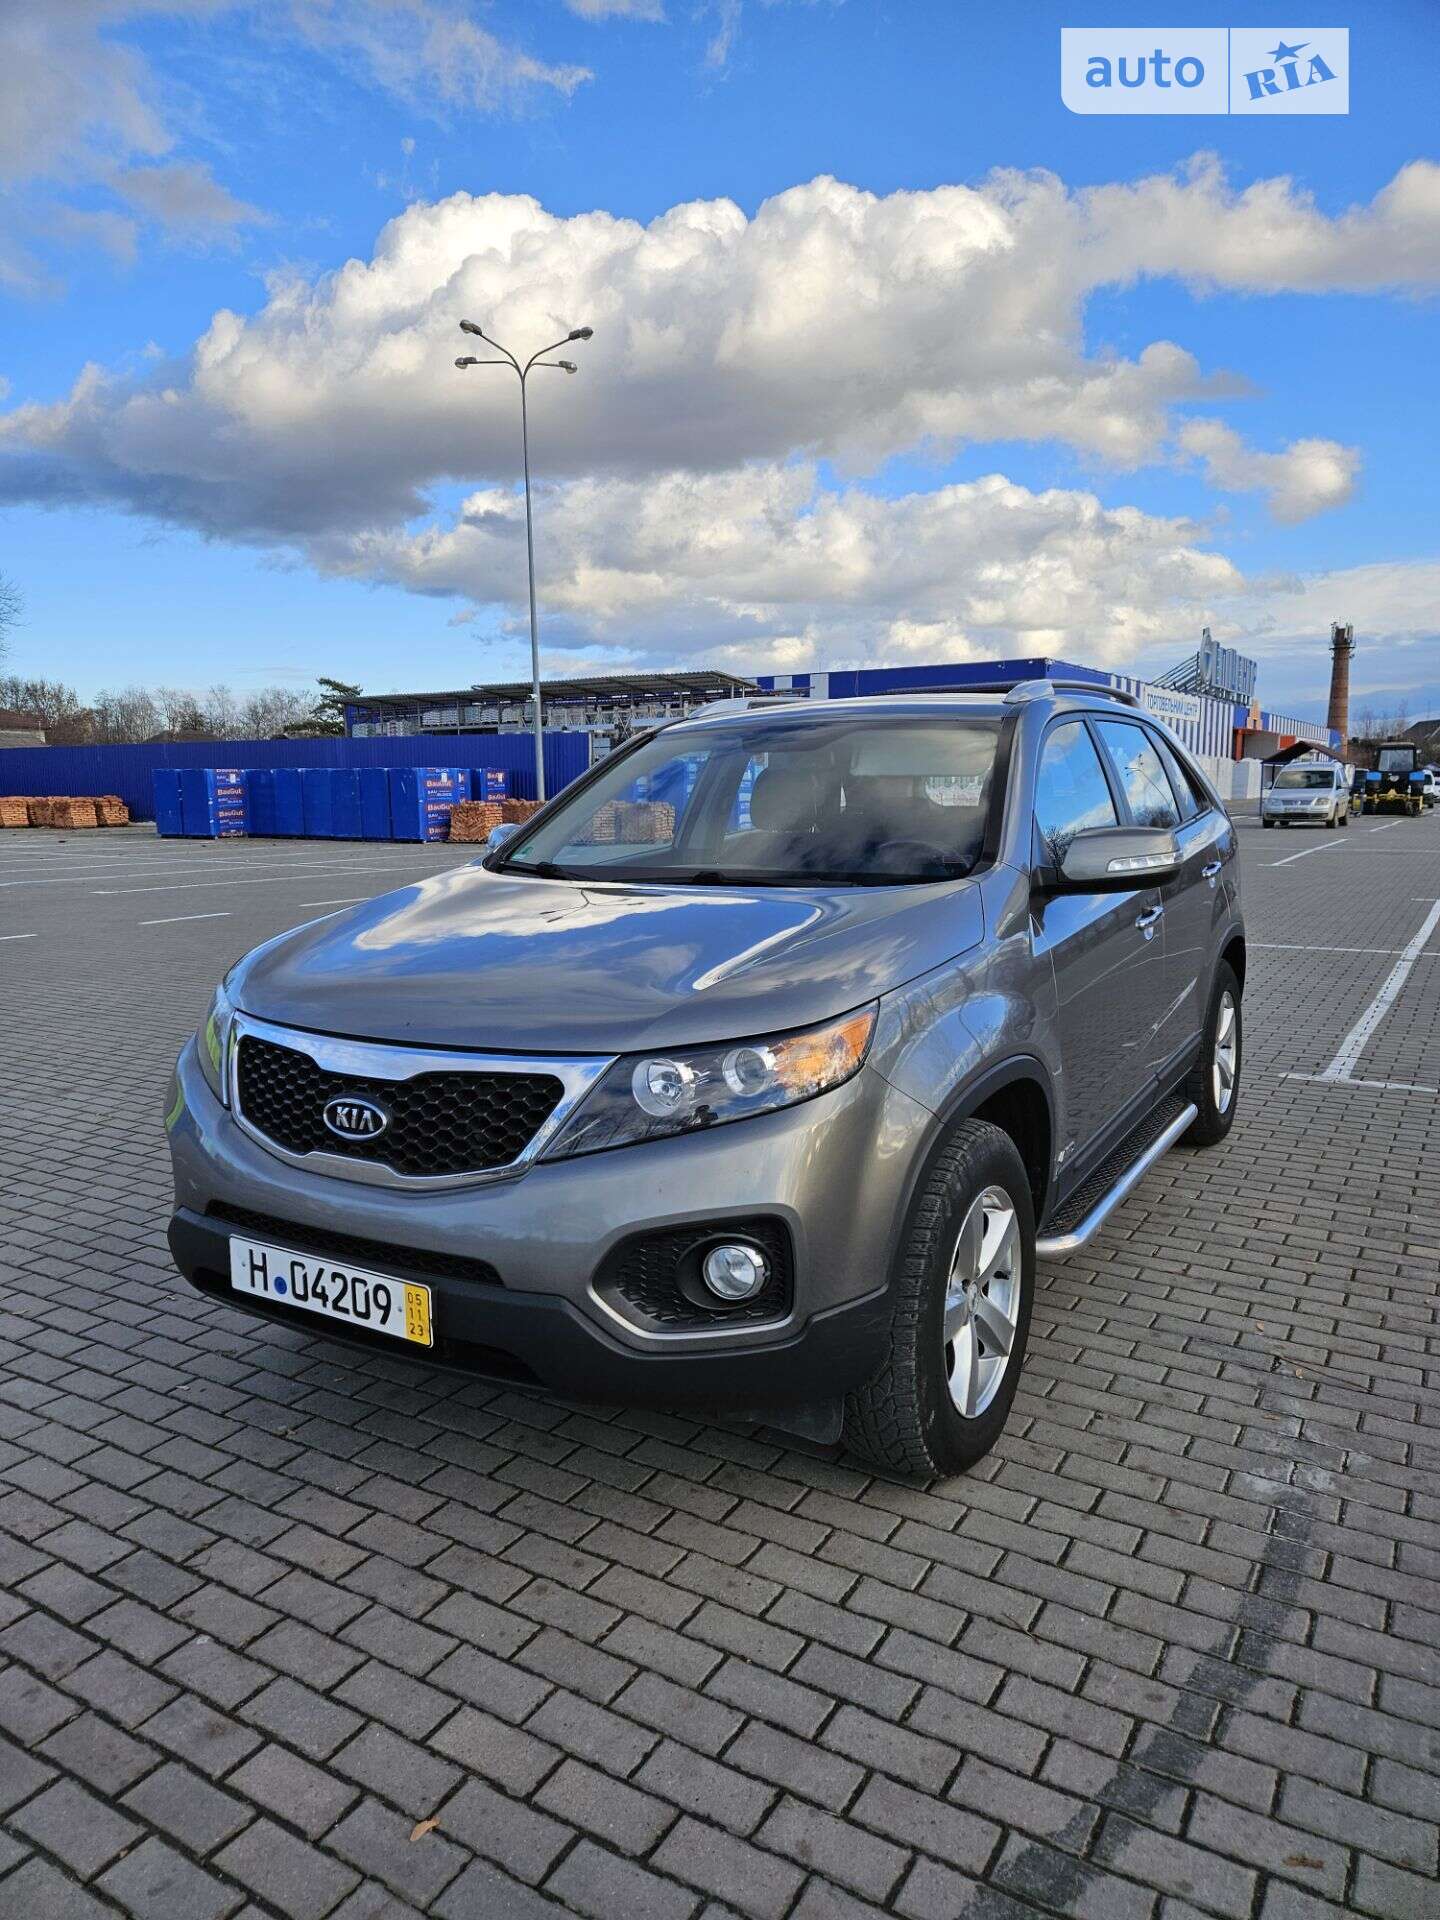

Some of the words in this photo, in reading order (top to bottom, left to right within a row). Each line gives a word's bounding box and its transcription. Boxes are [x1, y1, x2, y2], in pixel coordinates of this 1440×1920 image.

[335, 1106, 375, 1132] KIA
[248, 1249, 269, 1292] H
[289, 1260, 393, 1326] 04209
[406, 1291, 423, 1306] 05
[408, 1307, 423, 1323] 11
[409, 1322, 425, 1337] 23
